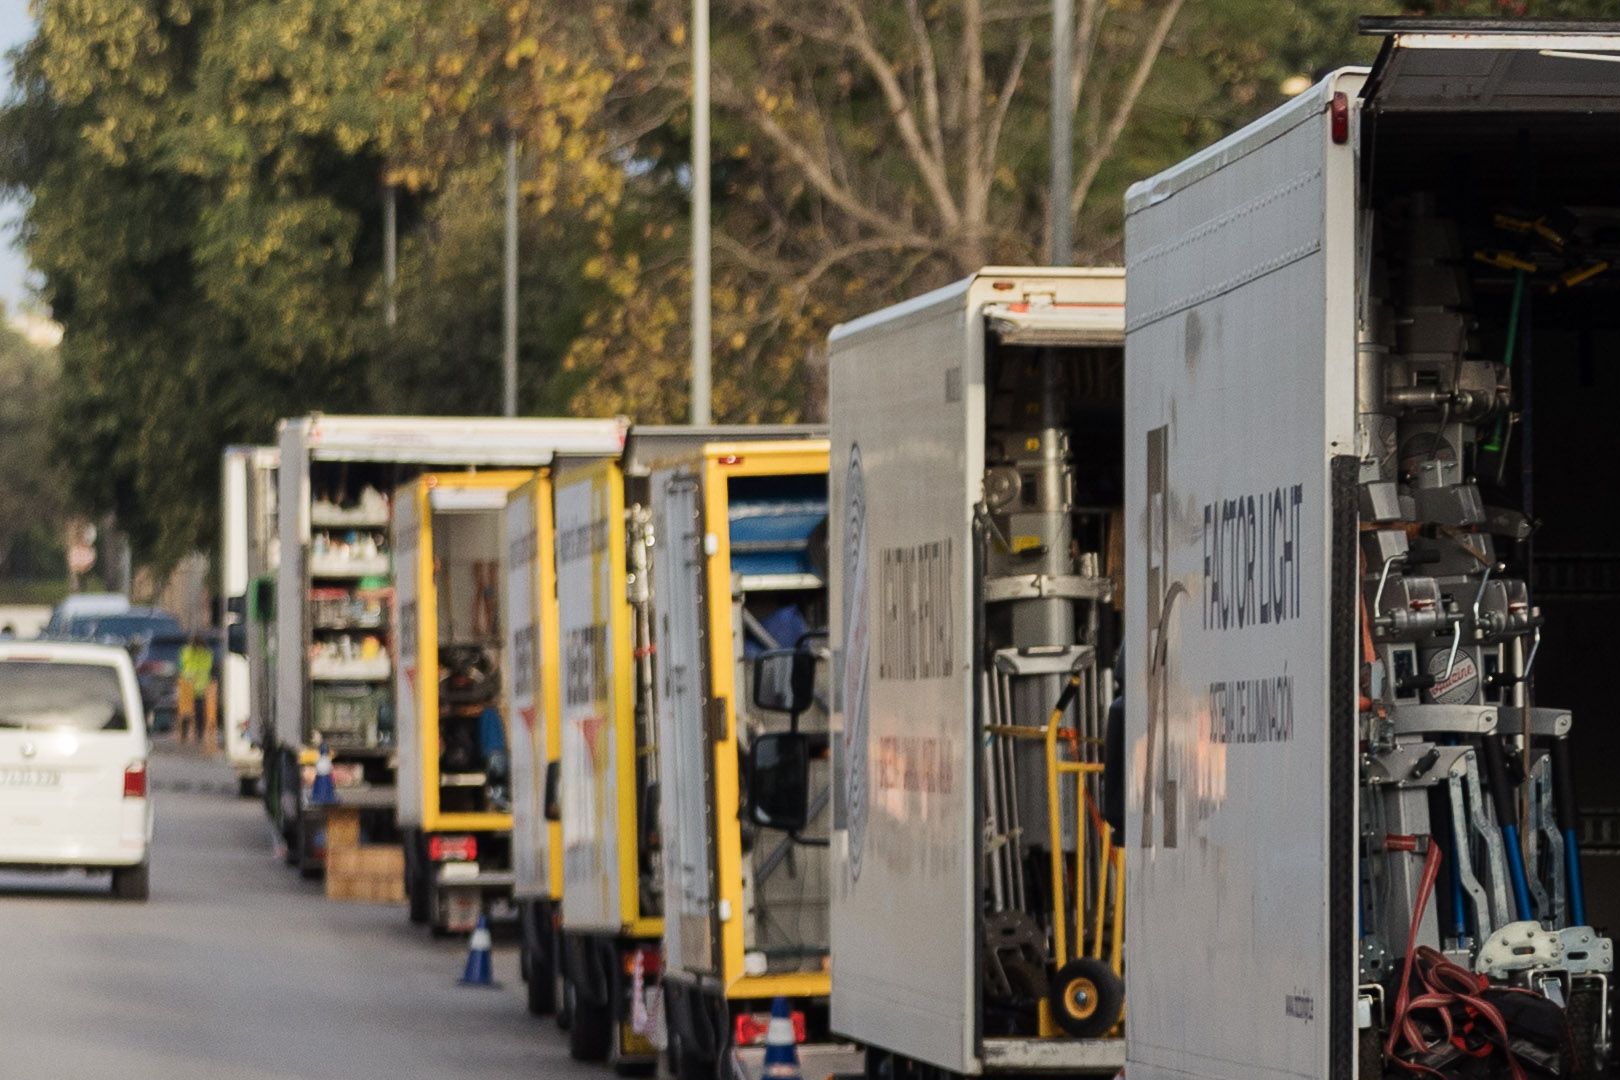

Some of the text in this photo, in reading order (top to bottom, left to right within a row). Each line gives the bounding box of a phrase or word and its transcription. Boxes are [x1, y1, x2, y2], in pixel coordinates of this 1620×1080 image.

[1203, 483, 1303, 630] FACTOR LIGHT
[1236, 680, 1246, 743] DE
